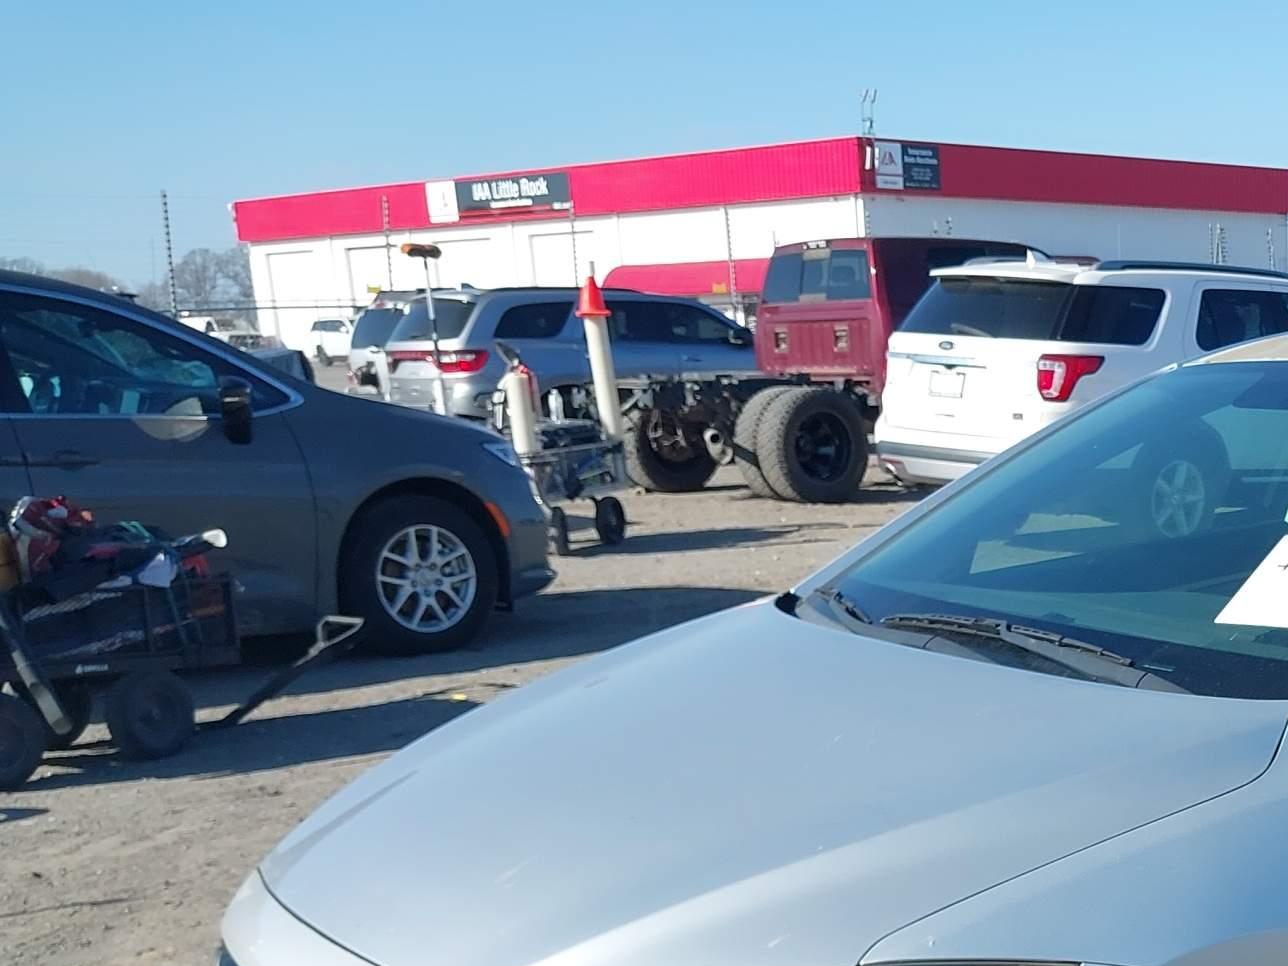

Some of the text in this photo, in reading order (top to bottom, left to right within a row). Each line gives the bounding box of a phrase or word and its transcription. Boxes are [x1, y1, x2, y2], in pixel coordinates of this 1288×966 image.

[472, 177, 549, 201] IAA Little Rock
